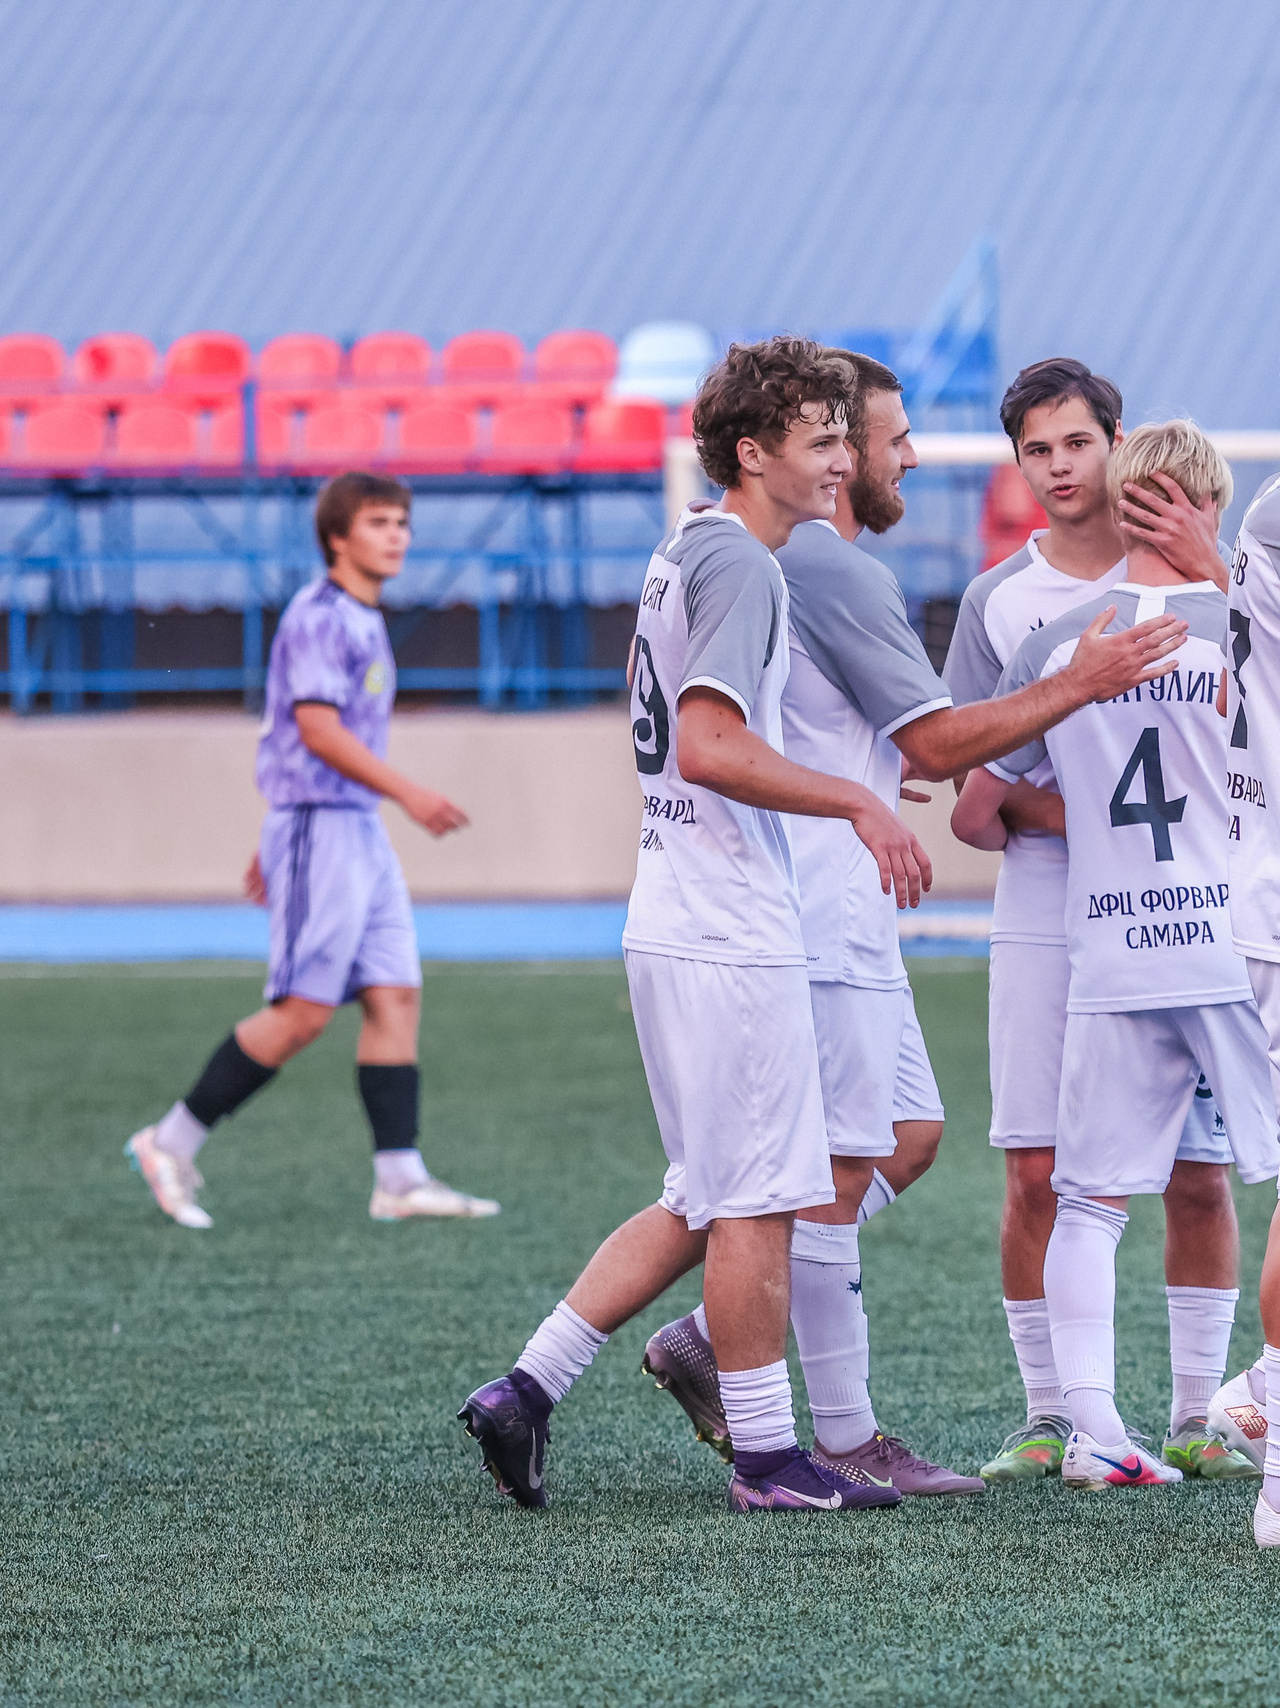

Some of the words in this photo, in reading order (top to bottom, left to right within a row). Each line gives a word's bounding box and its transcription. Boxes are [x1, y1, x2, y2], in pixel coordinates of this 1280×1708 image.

[1108, 727, 1189, 862] 4
[1087, 891, 1137, 920] ДФЦ
[1140, 883, 1230, 913] ФОРВАР
[1125, 920, 1216, 950] САМАРА
